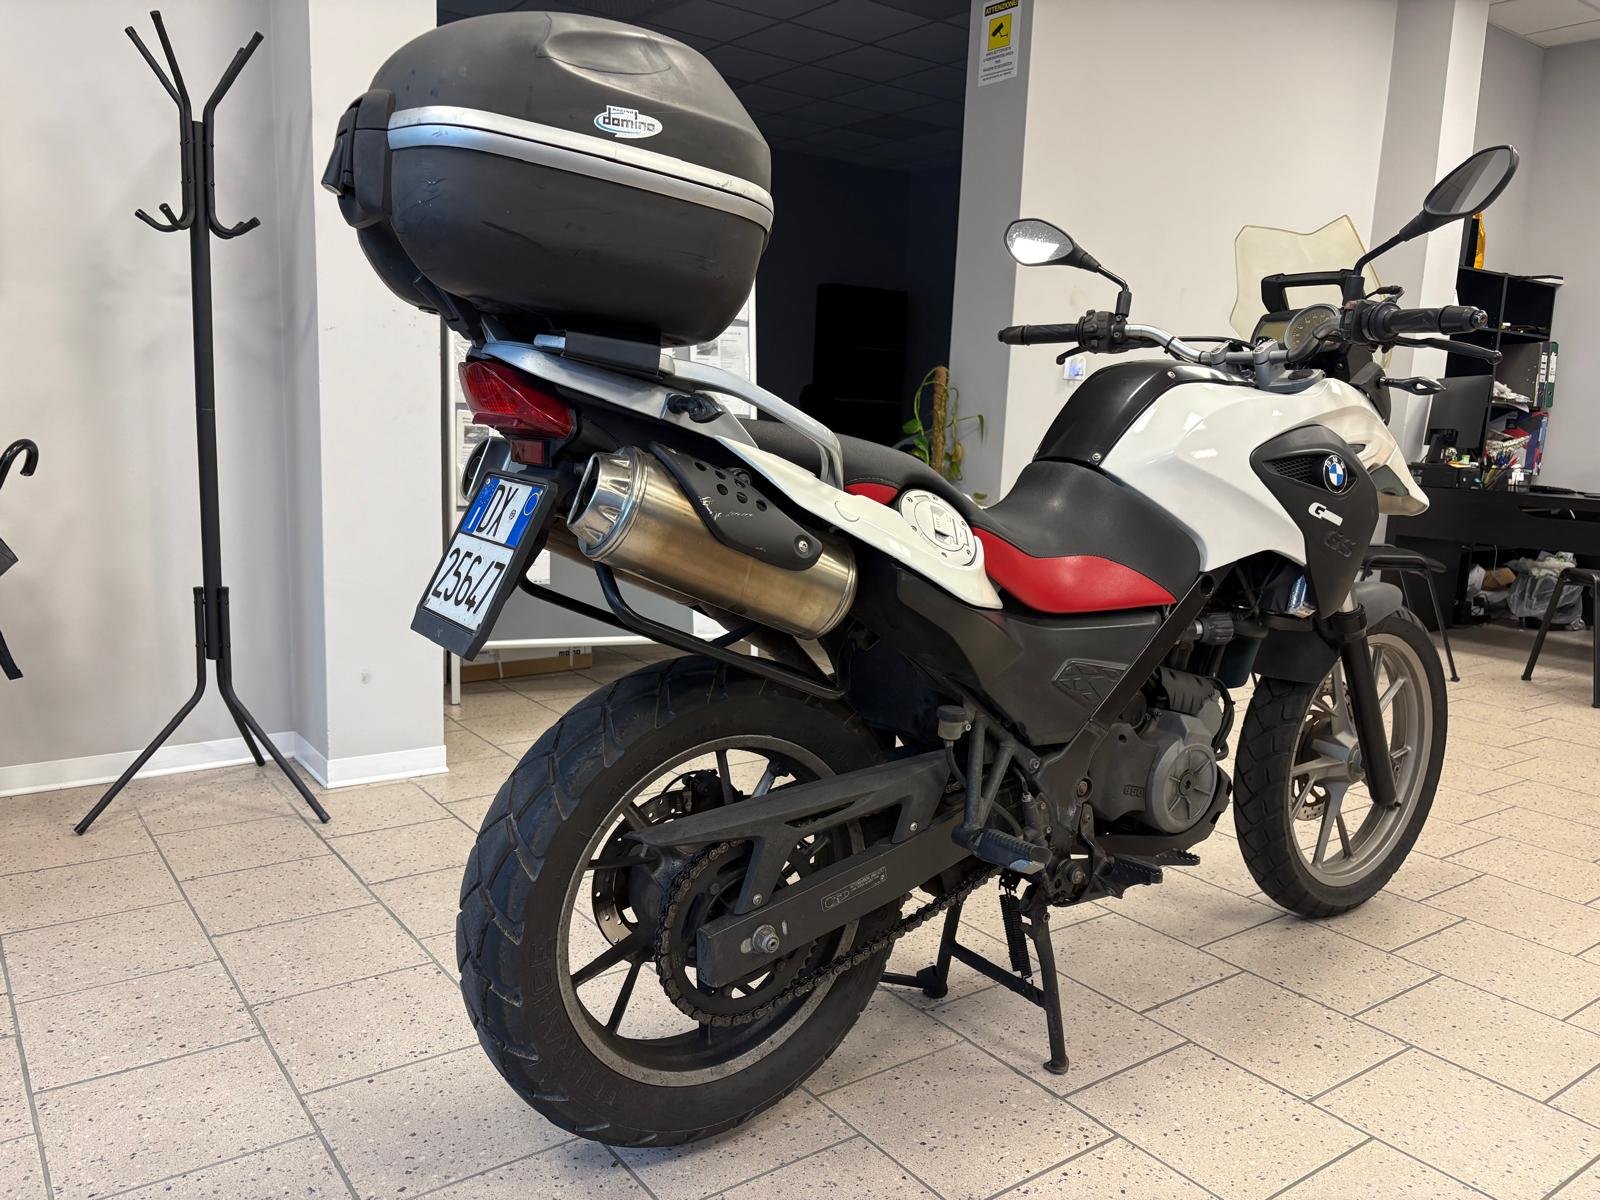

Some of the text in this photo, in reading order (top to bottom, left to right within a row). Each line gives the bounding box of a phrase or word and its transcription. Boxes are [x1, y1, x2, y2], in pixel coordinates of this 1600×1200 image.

[602, 106, 656, 132] domino
[475, 485, 519, 538] DX
[431, 547, 506, 615] 25647
